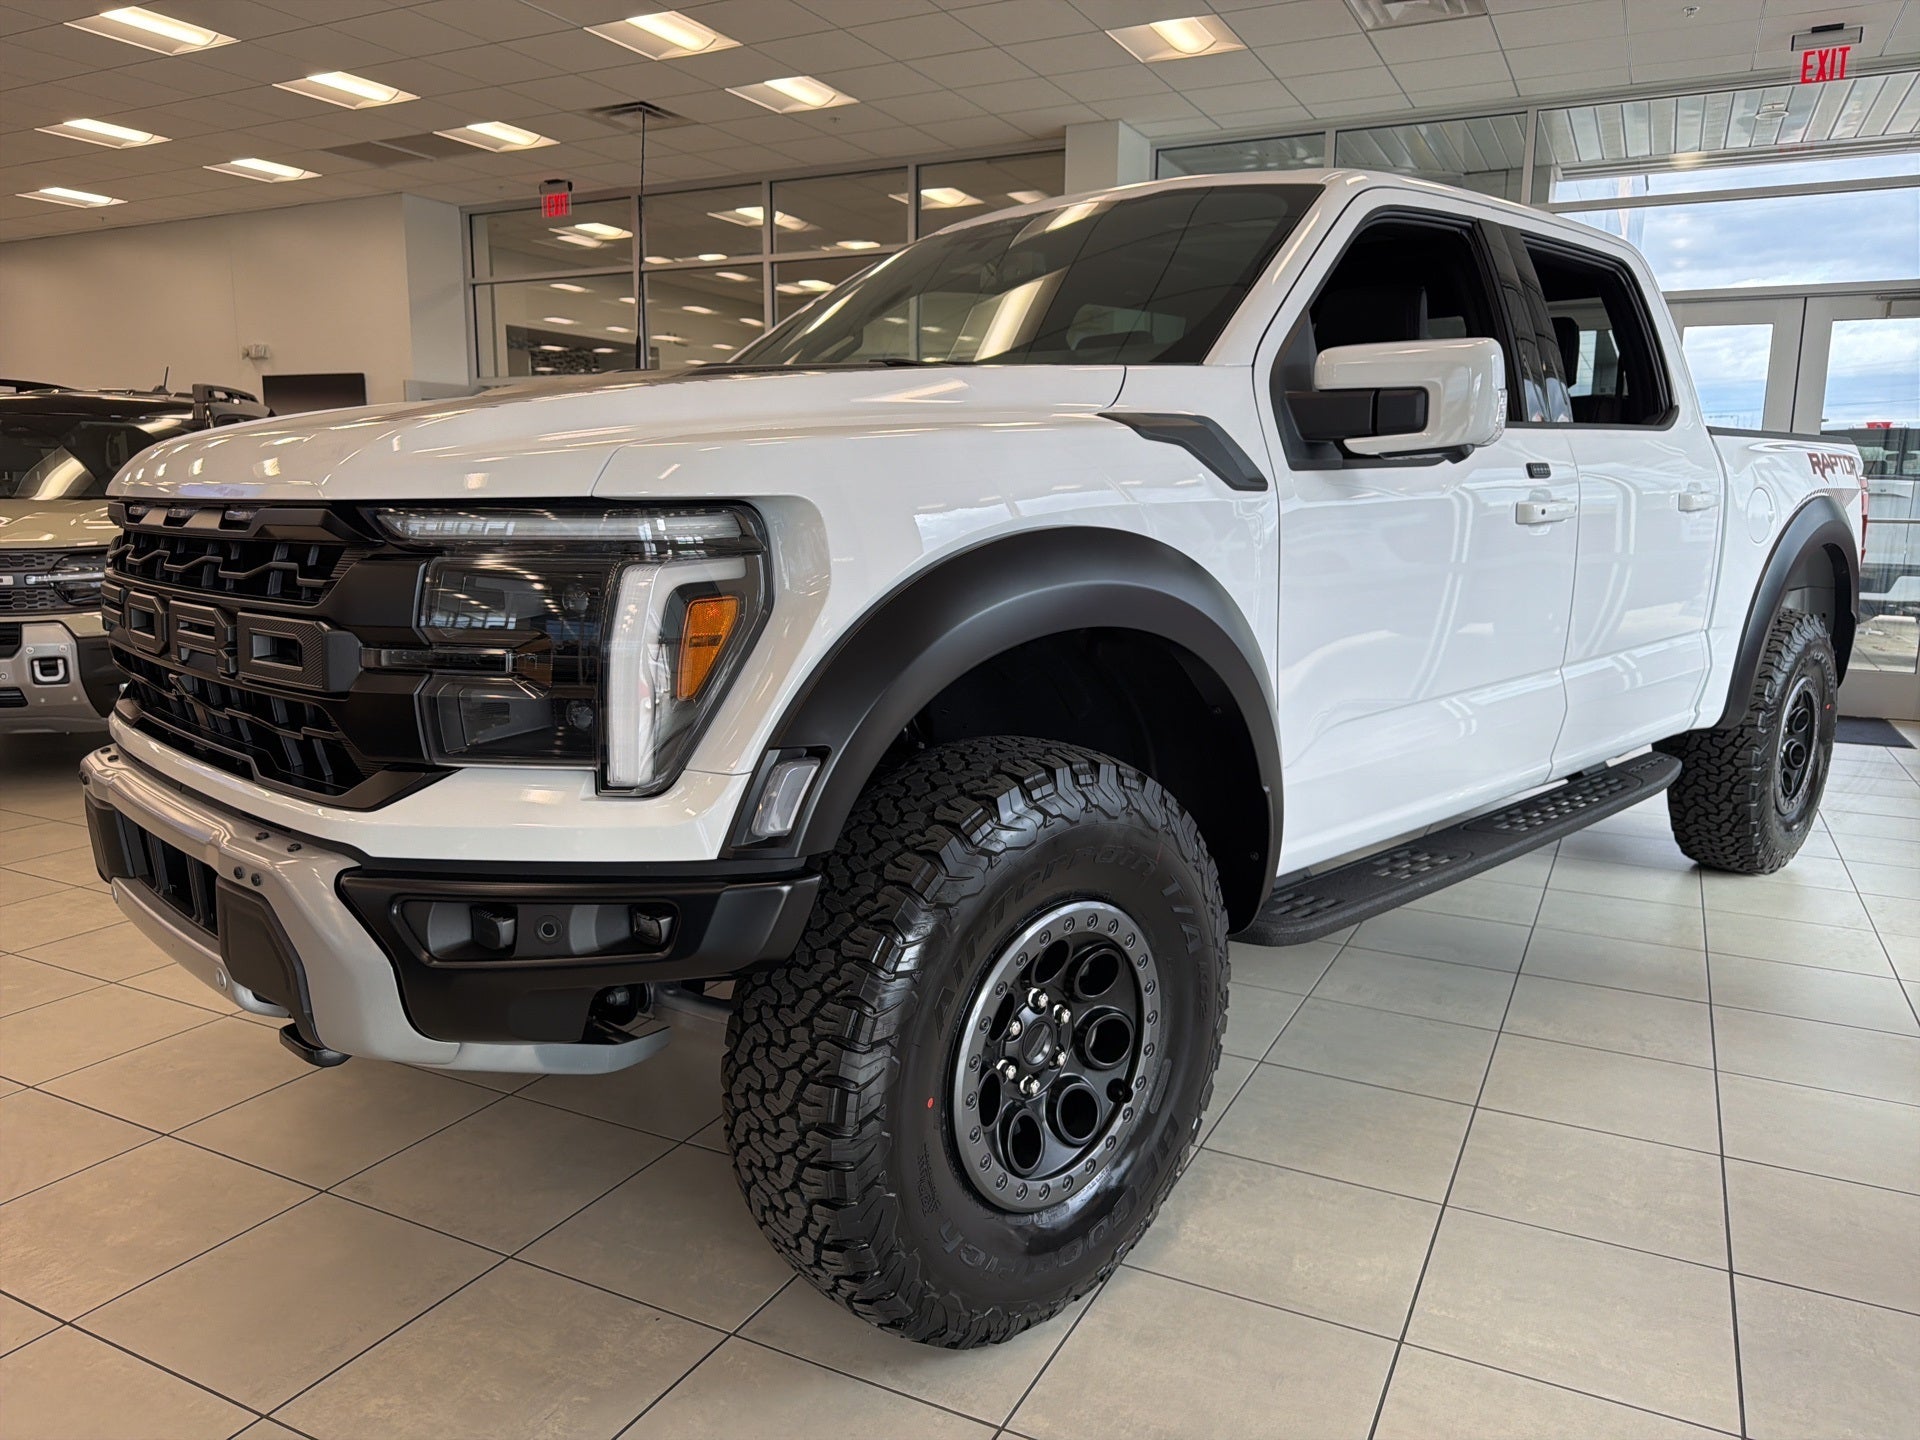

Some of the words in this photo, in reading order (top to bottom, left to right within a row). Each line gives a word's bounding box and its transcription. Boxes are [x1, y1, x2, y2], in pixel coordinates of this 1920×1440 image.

[1800, 46, 1850, 84] EXIT
[546, 192, 569, 217] EXIT
[1807, 452, 1859, 484] RAPTOR
[101, 578, 330, 692] FORD
